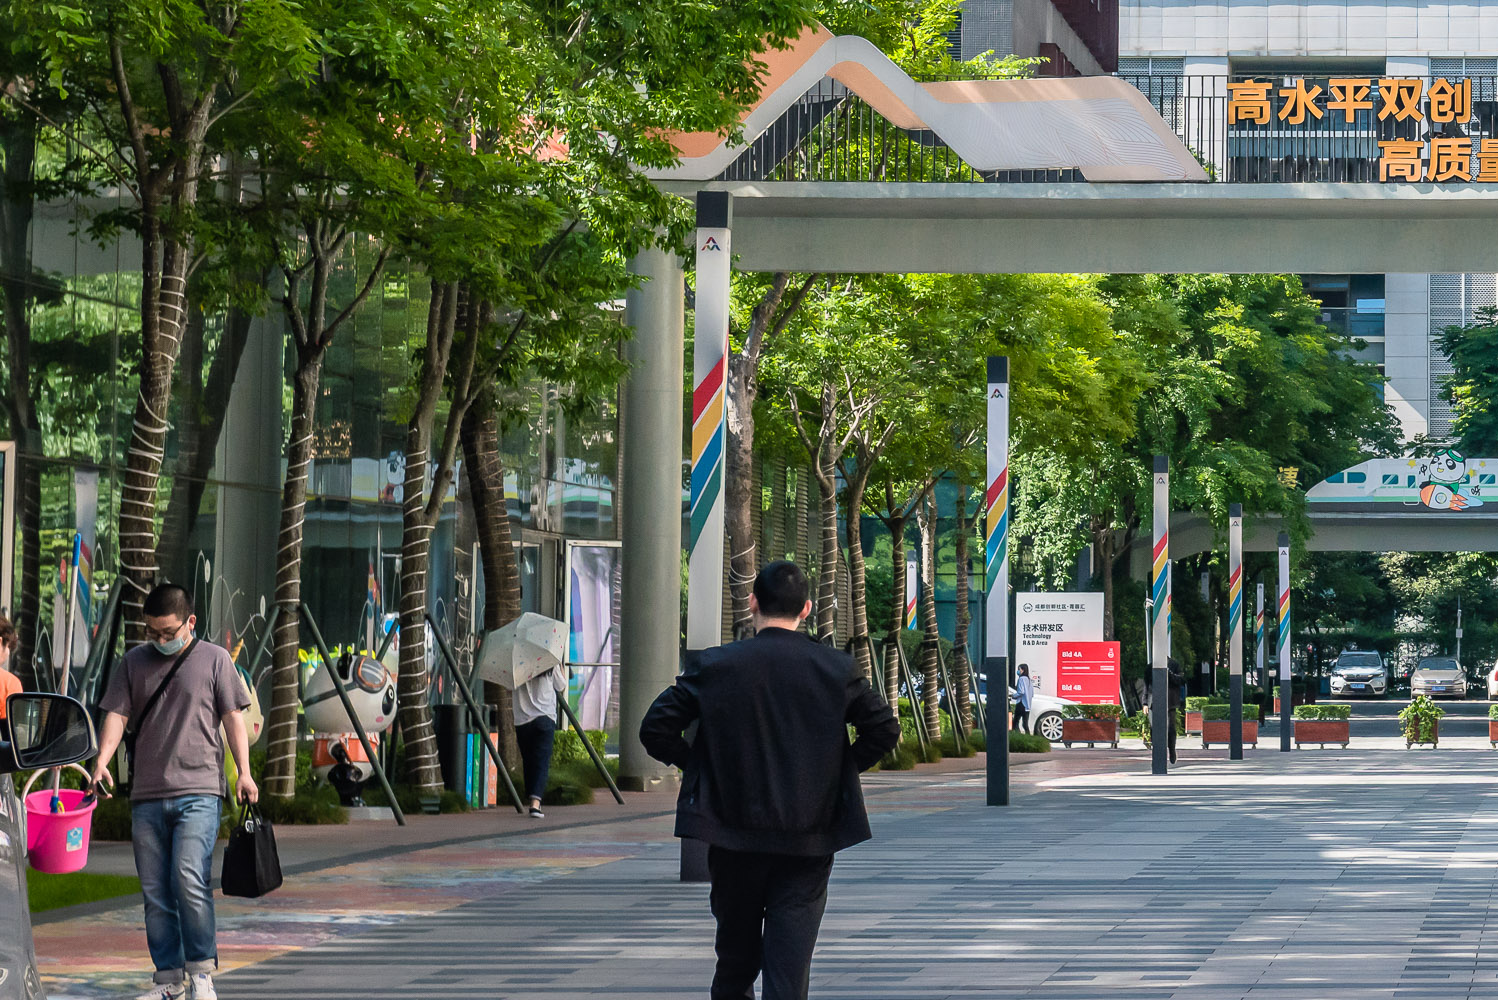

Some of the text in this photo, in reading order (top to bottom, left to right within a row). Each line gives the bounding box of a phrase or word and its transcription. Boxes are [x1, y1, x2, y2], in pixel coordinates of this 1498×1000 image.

[1226, 78, 1472, 125] 高水平双创
[1023, 623, 1064, 632] 技术研发区
